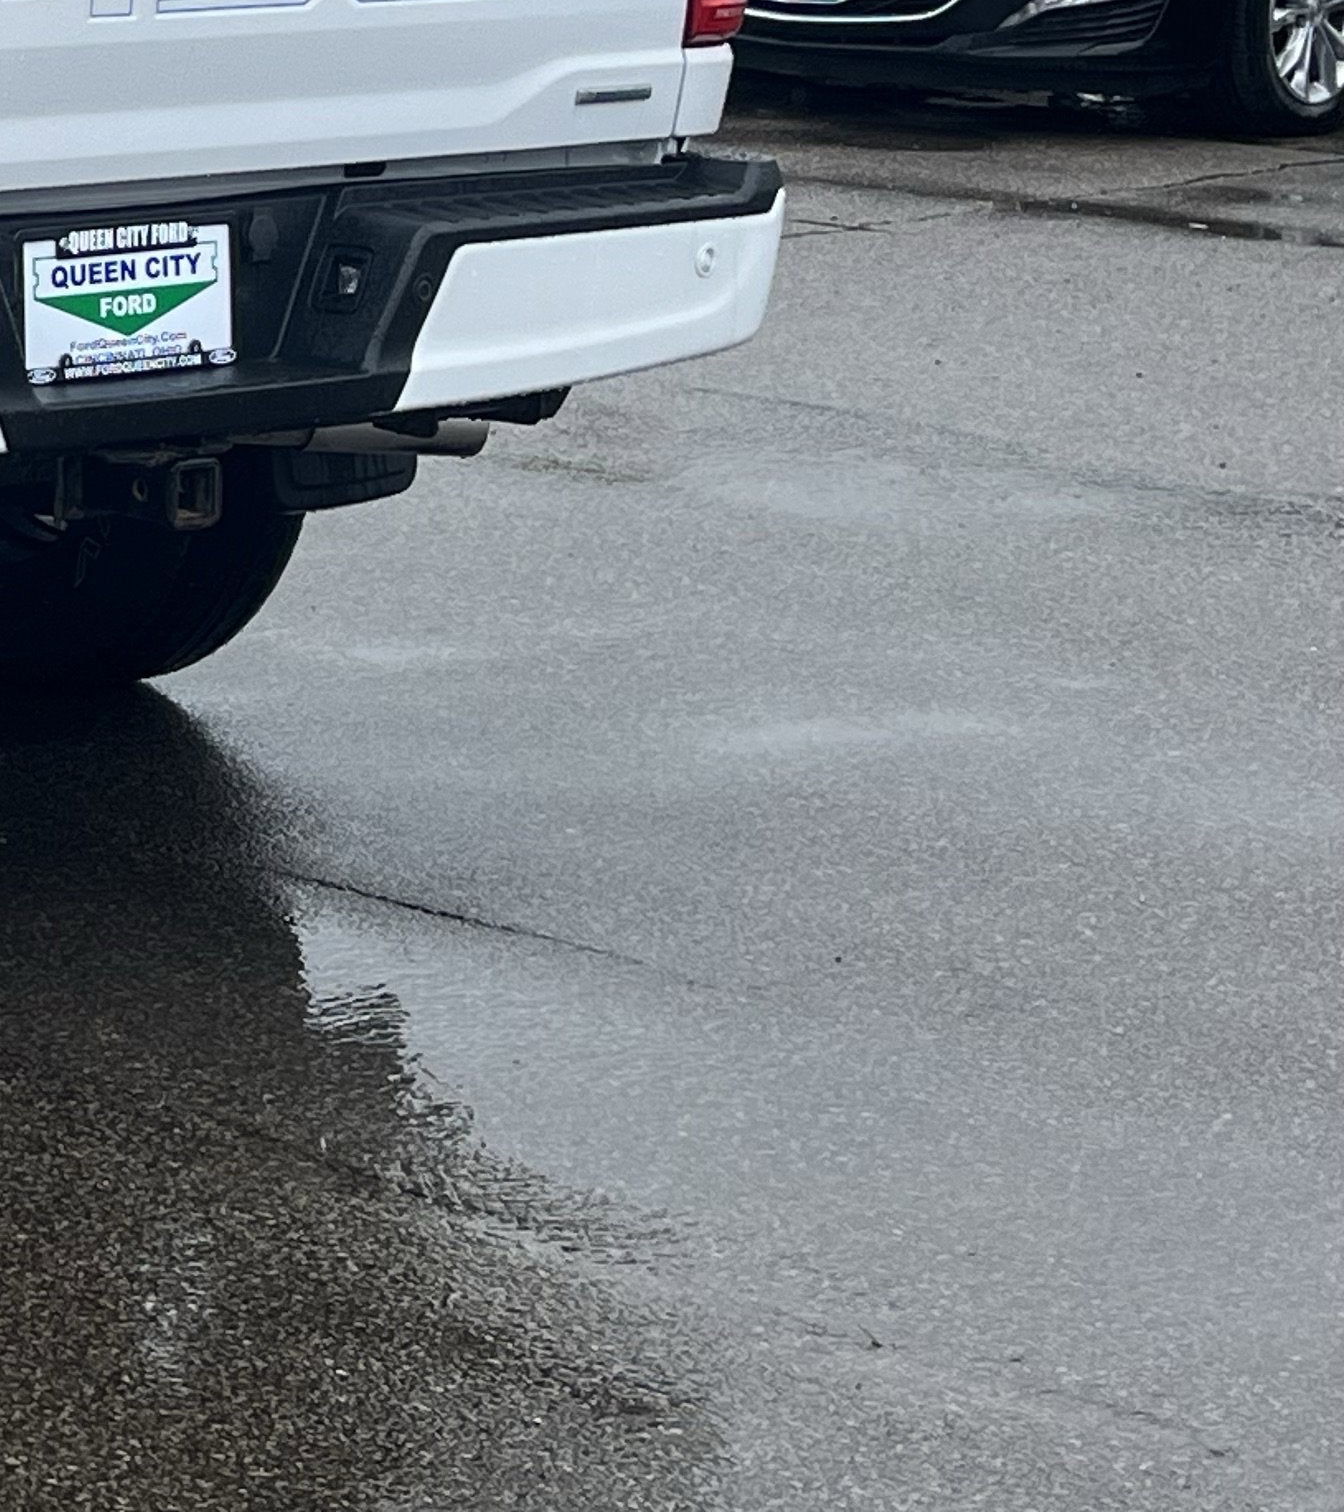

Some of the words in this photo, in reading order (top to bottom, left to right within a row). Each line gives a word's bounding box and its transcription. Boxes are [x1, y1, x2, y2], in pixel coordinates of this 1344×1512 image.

[68, 227, 114, 254] QUEEN
[116, 224, 150, 248] CITY
[150, 221, 189, 245] FORD
[51, 259, 136, 289] QUEEN
[145, 252, 202, 279] CITY
[99, 293, 158, 318] FORD
